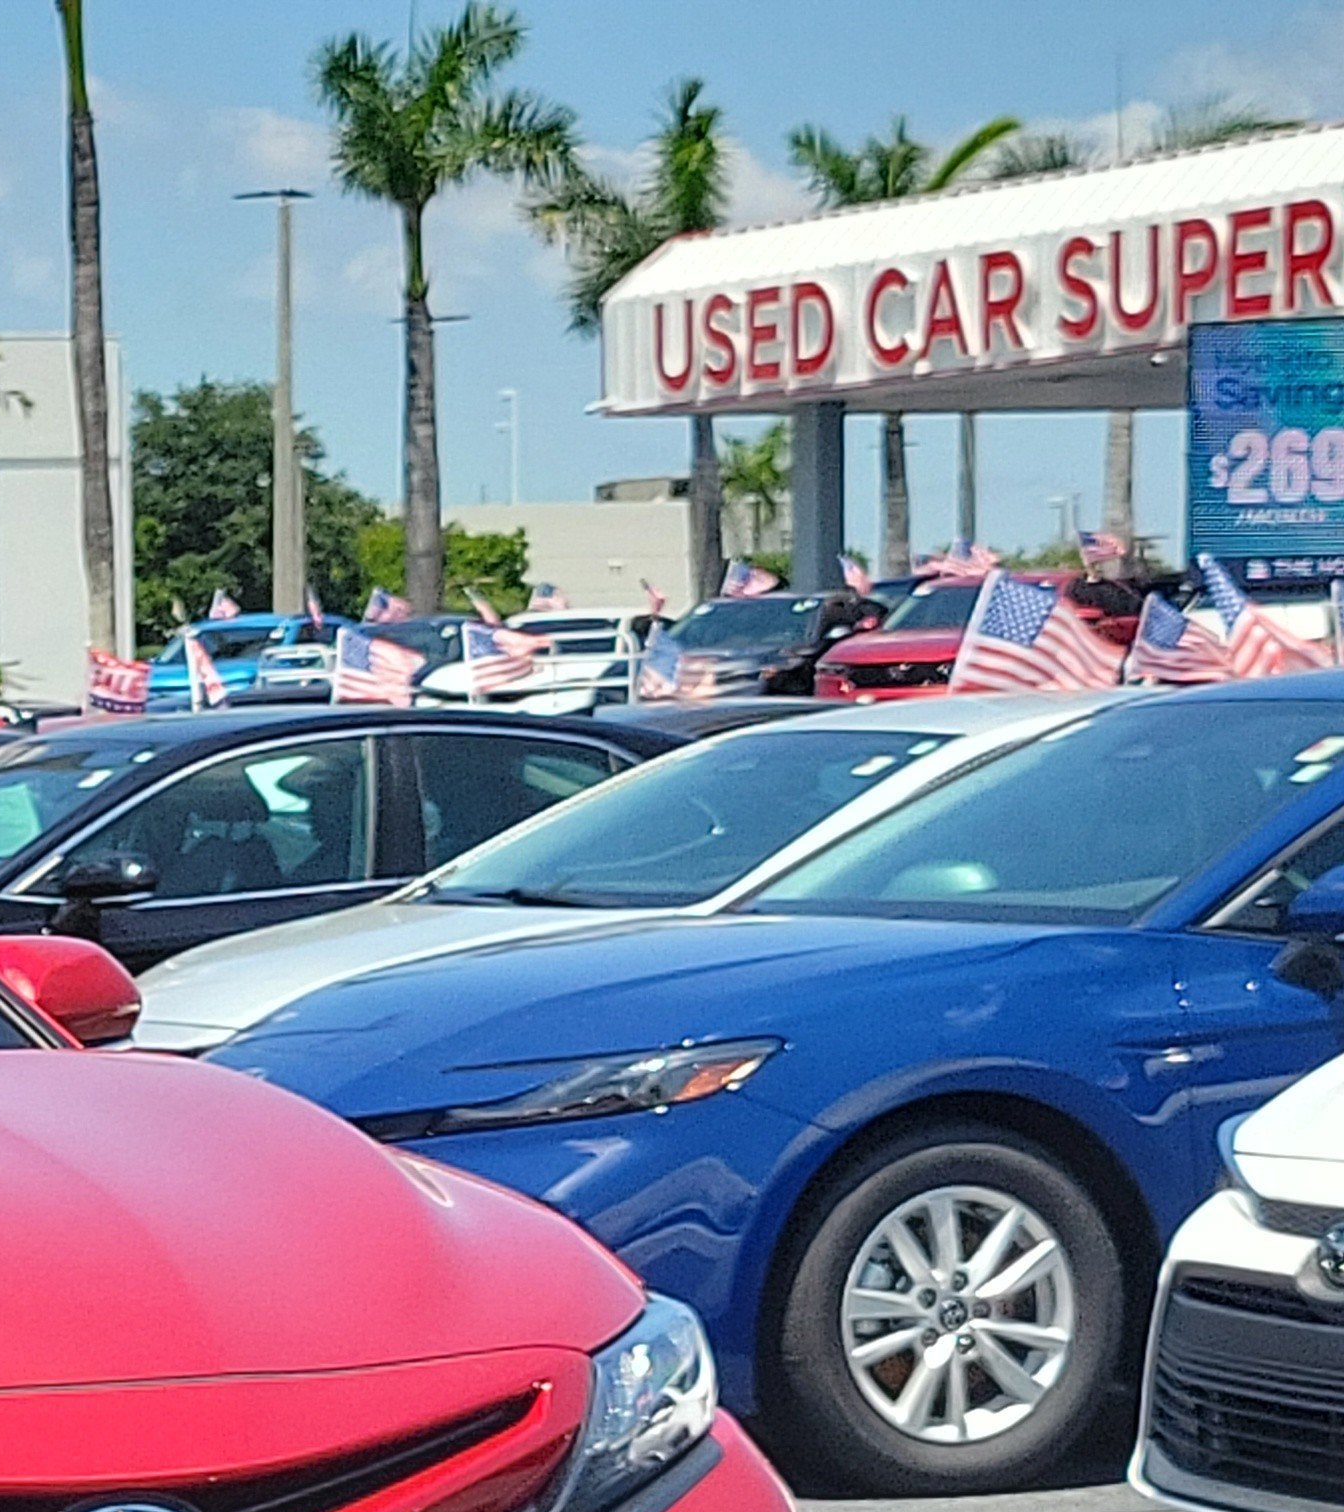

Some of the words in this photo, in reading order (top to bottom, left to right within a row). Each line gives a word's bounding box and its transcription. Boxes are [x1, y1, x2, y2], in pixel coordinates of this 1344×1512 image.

[653, 281, 834, 391] USED
[866, 250, 1028, 366] CAR
[1058, 199, 1339, 339] SUPER
[1209, 428, 1344, 504] $269
